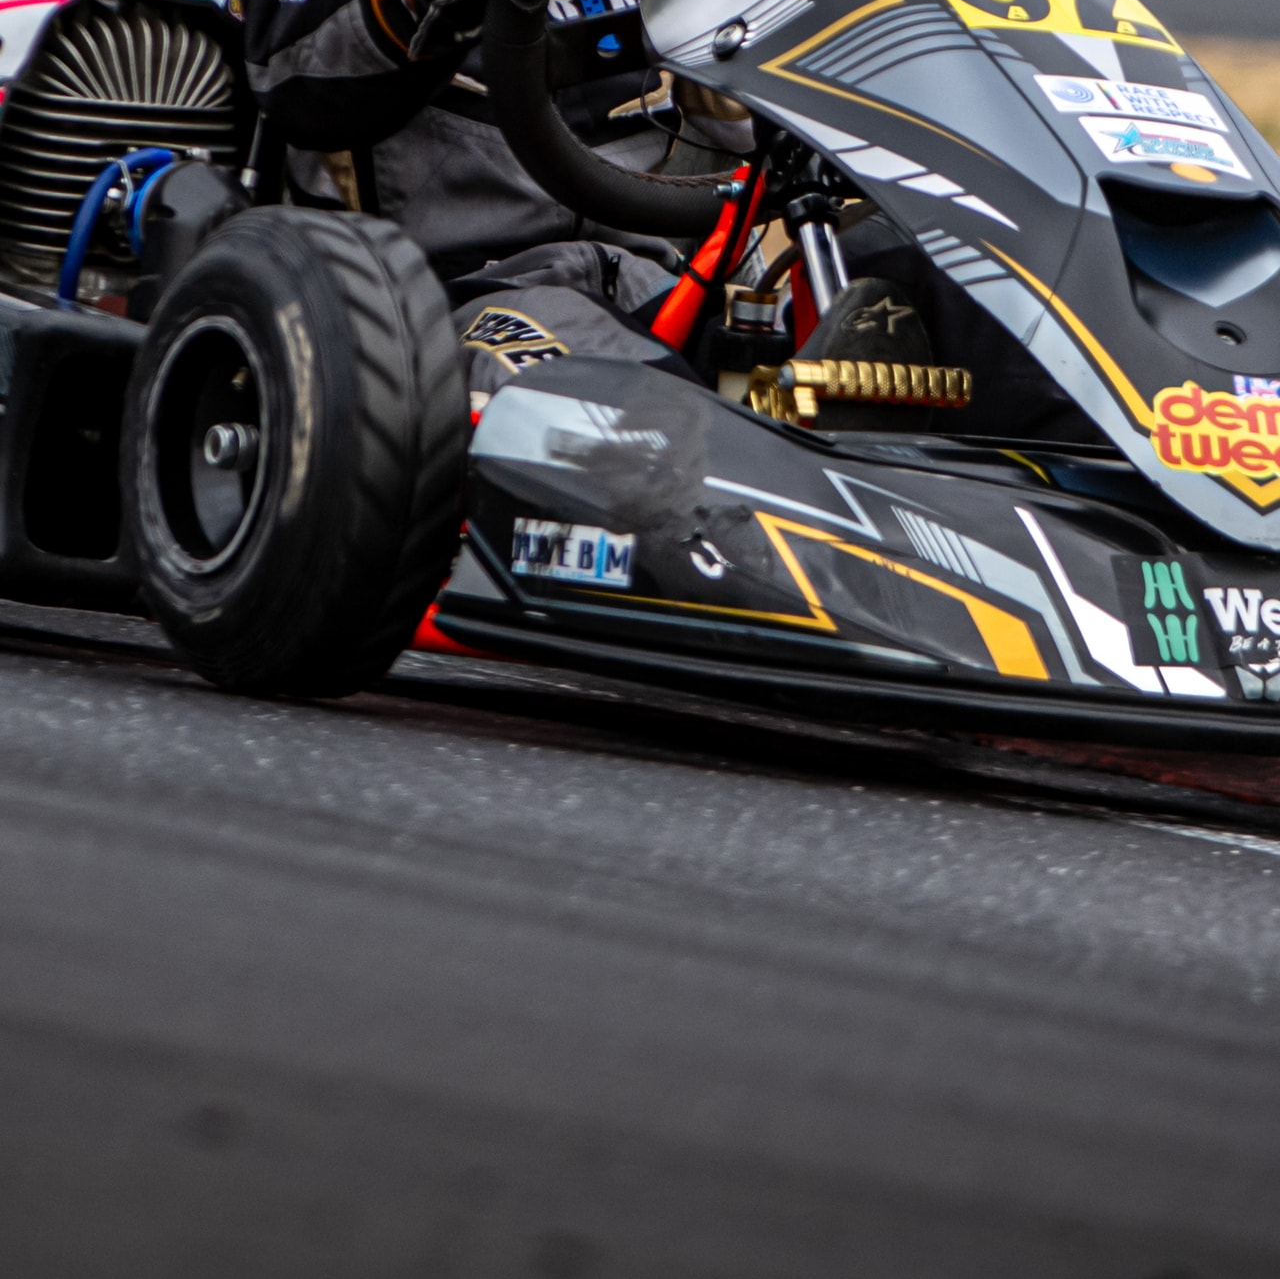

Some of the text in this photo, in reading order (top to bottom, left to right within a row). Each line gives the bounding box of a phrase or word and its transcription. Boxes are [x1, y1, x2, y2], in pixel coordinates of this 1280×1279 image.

[1117, 84, 1170, 99] RACE
[1123, 94, 1177, 110] WITH
[1131, 104, 1218, 127] RESPECT
[1229, 634, 1253, 653] BE
[1257, 637, 1270, 650] A
